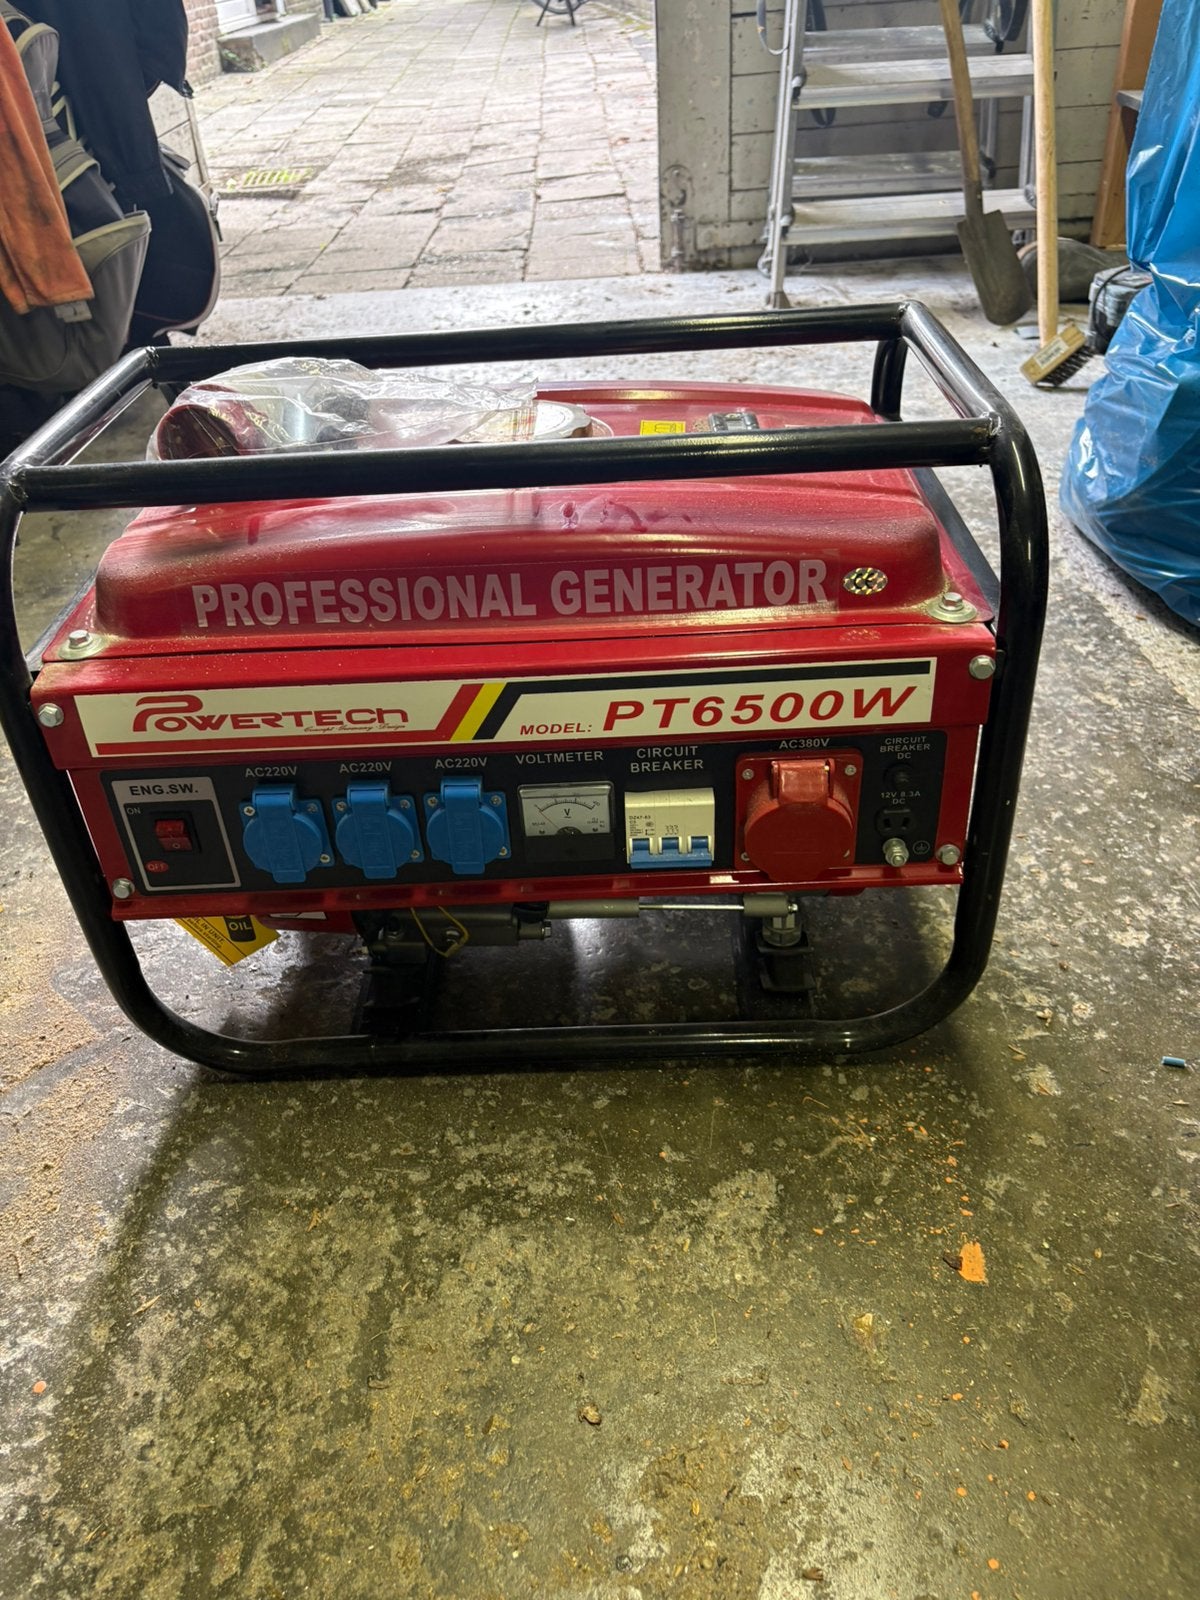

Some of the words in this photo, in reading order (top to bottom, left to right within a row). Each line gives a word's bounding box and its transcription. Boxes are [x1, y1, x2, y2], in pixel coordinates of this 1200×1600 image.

[191, 573, 537, 628] PROFESSIONAL
[550, 559, 829, 615] GENERATOR
[519, 723, 593, 736] MODEL:
[602, 685, 918, 731] PT6500W
[779, 738, 830, 750] AC380V
[884, 736, 927, 745] CIRCUIT
[636, 746, 699, 759] CIRCUIT
[880, 743, 930, 753] BREAKER
[515, 751, 604, 765] VOLTMETER
[897, 752, 912, 760] DC
[339, 761, 392, 774] AC220V
[434, 757, 488, 769] AC220V
[630, 759, 704, 773] BREAKER
[245, 766, 298, 778] AC220V
[129, 783, 199, 796] ENG.SW.
[880, 791, 897, 799] 12V
[126, 807, 141, 815] ON
[228, 921, 252, 931] OIL
